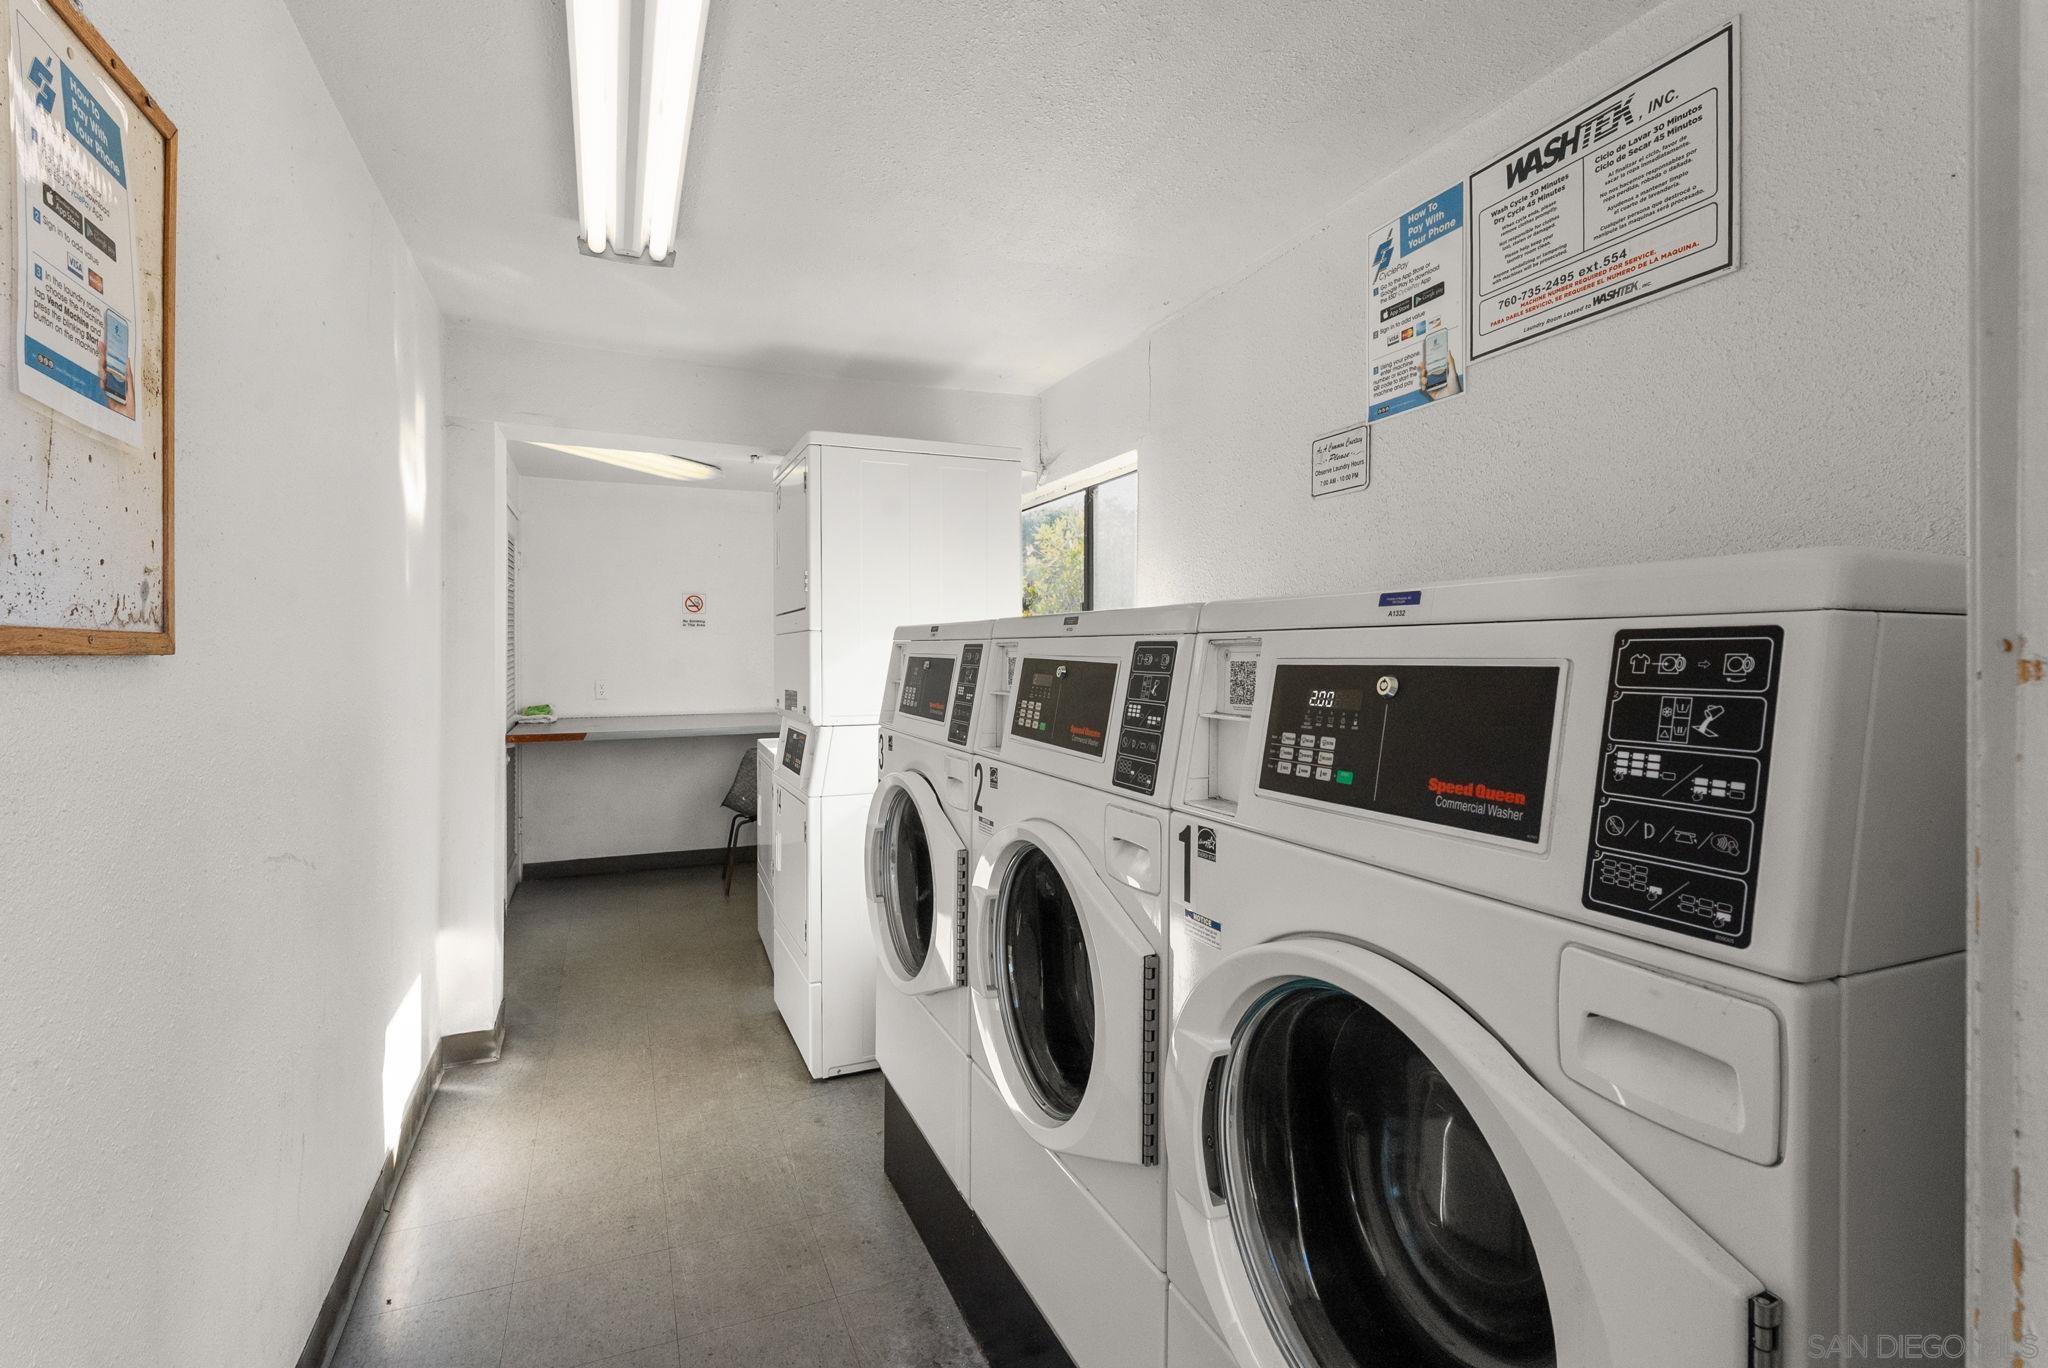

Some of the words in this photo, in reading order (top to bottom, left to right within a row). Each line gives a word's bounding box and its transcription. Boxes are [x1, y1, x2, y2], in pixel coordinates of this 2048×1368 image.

[70, 77, 89, 107] How
[90, 100, 100, 120] To
[1648, 90, 1678, 113] INC.
[72, 97, 88, 126] Pay
[90, 117, 108, 146] With
[1595, 150, 1614, 163] Ciclo
[1616, 144, 1626, 153] de
[1628, 131, 1651, 146] Lavar
[1653, 123, 1665, 133] 30
[1667, 104, 1702, 126] Minutos
[74, 118, 93, 147] Your
[95, 140, 120, 176] Phone
[1595, 160, 1614, 173] Ciclo
[1616, 154, 1626, 162] de
[1628, 141, 1651, 156] Secar
[1653, 133, 1665, 143] 45
[1667, 115, 1702, 137] Minutos
[1491, 206, 1508, 217] Wash
[1510, 196, 1528, 208] Cycle
[1530, 189, 1539, 198] 30
[1541, 174, 1569, 192] Minutes
[1494, 216, 1505, 225] Dry
[1507, 206, 1525, 218] Cycle
[1527, 199, 1536, 207] 45
[1538, 185, 1565, 203] Minutes
[1408, 209, 1426, 224] How
[1428, 203, 1438, 212] To
[1408, 223, 1423, 237] Pay
[1425, 211, 1444, 226] With
[43, 215, 56, 232] Sign
[57, 228, 63, 238] in
[64, 232, 70, 243] to
[71, 240, 83, 254] add
[84, 250, 99, 266] value
[1409, 234, 1426, 248] Your
[1428, 219, 1456, 238] Phone
[70, 258, 82, 272] VISA
[1379, 262, 1408, 280] CyclePay
[1380, 286, 1397, 297] Google
[1415, 264, 1440, 281] download
[1402, 272, 1412, 280] App
[1412, 266, 1424, 275] Store
[1499, 272, 1574, 309] 760-735-2495
[1579, 249, 1627, 276] ext.554
[45, 270, 51, 282] In
[52, 276, 62, 290] the
[64, 284, 85, 306] laundry
[46, 284, 68, 304] choose
[69, 299, 78, 311] the
[1490, 318, 1504, 327] PARA
[1506, 310, 1523, 321] DARLE
[1564, 282, 1595, 298] REQUIERE
[1607, 266, 1636, 281] NUMERO
[1638, 261, 1647, 269] DE
[1521, 294, 1546, 307] MACHINE
[1548, 283, 1573, 296] NUMBER
[1575, 269, 1607, 286] REQUIRED
[1609, 263, 1623, 272] FOR
[34, 287, 45, 300] tap
[47, 294, 62, 312] Vend
[64, 306, 89, 329] Machine
[90, 325, 101, 337] and
[34, 300, 50, 315] press
[52, 310, 61, 322] the
[63, 317, 85, 339] blinking
[86, 332, 98, 346] Start
[1401, 316, 1411, 325] add
[1412, 311, 1425, 320] value
[1315, 468, 1332, 477] Observe
[1333, 464, 1350, 472] Laundry
[1329, 452, 1350, 462] Please
[1308, 690, 1335, 708] 2.00
[878, 736, 884, 770] 3
[974, 762, 982, 808] 2
[1428, 778, 1473, 796] Speed
[1476, 784, 1526, 805] Queen
[1435, 795, 1485, 815] Commercial
[1488, 804, 1524, 821] Washer
[1179, 824, 1191, 904] 1
[1194, 912, 1212, 927] NOTICE
